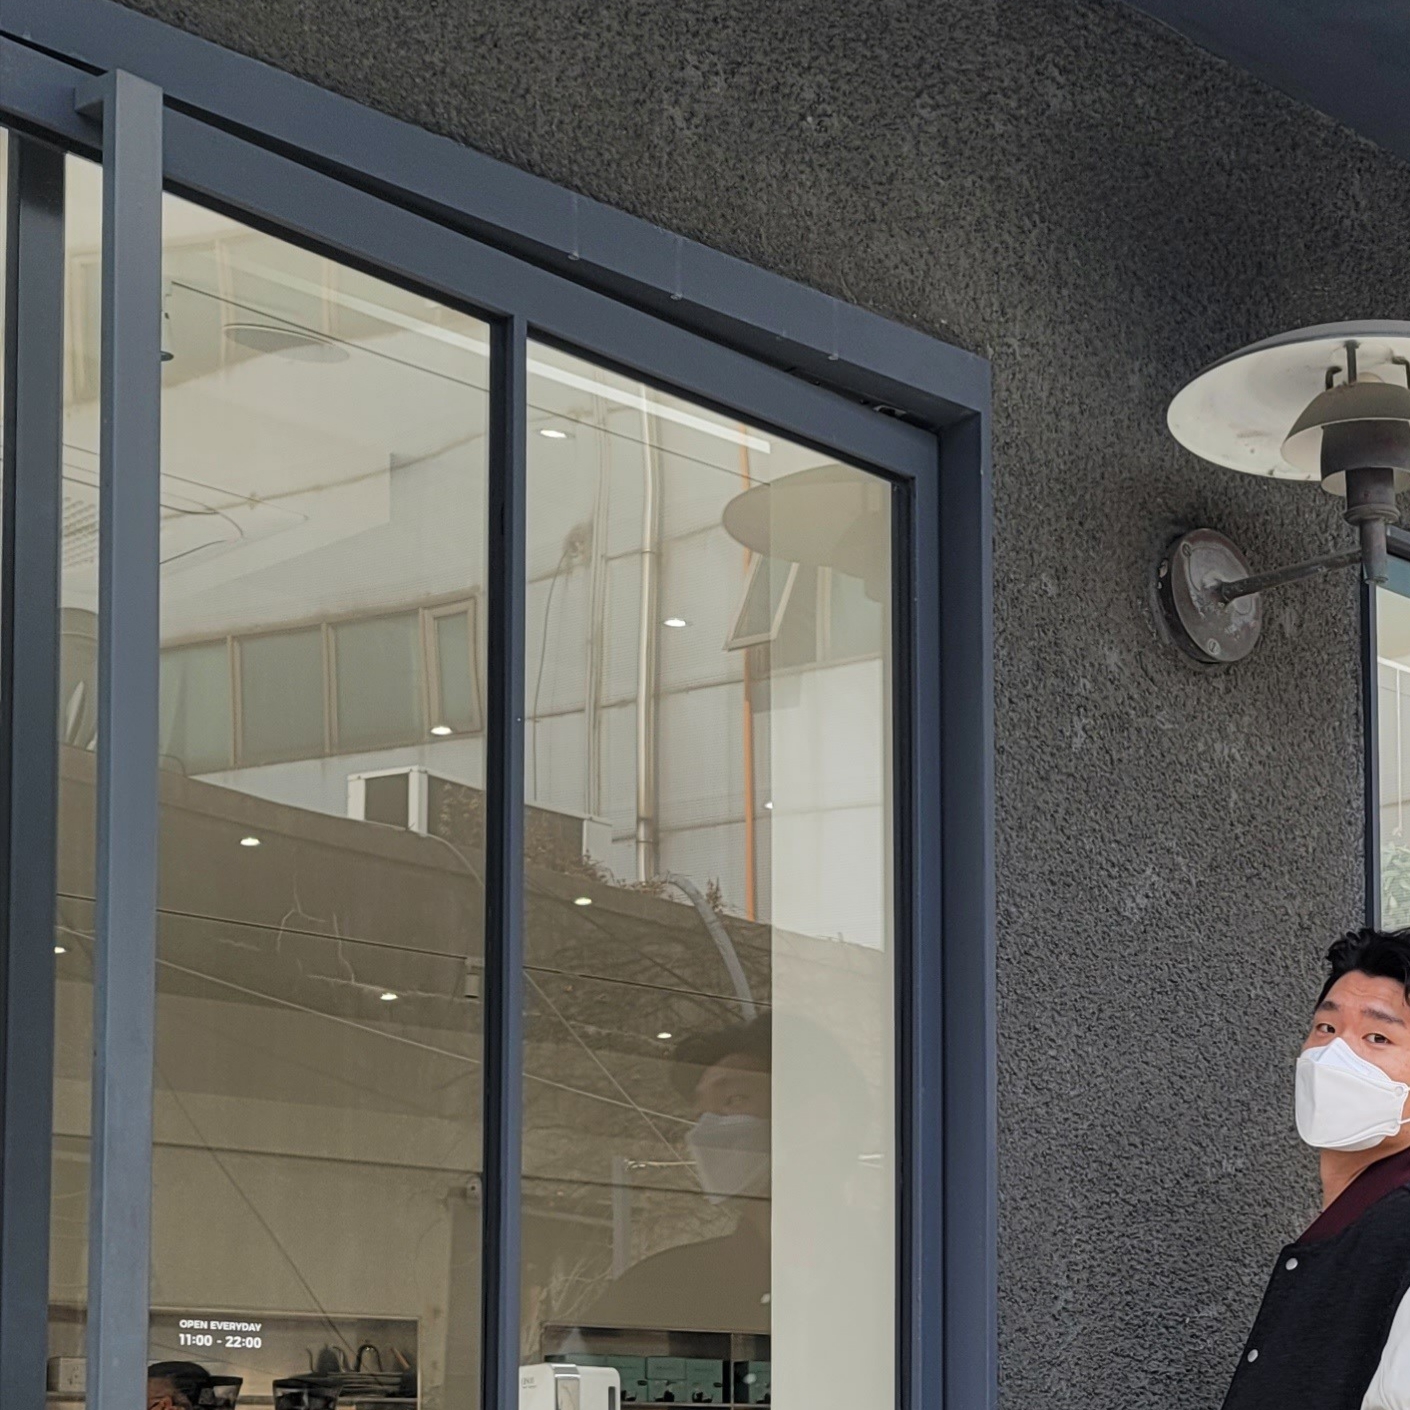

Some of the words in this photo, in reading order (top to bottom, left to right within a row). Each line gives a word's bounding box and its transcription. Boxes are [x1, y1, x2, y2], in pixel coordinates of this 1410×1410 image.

[179, 1319, 208, 1329] OPEN
[210, 1320, 262, 1332] EVERYDAY
[179, 1333, 213, 1347] 11:00
[225, 1335, 262, 1349] 22:00
